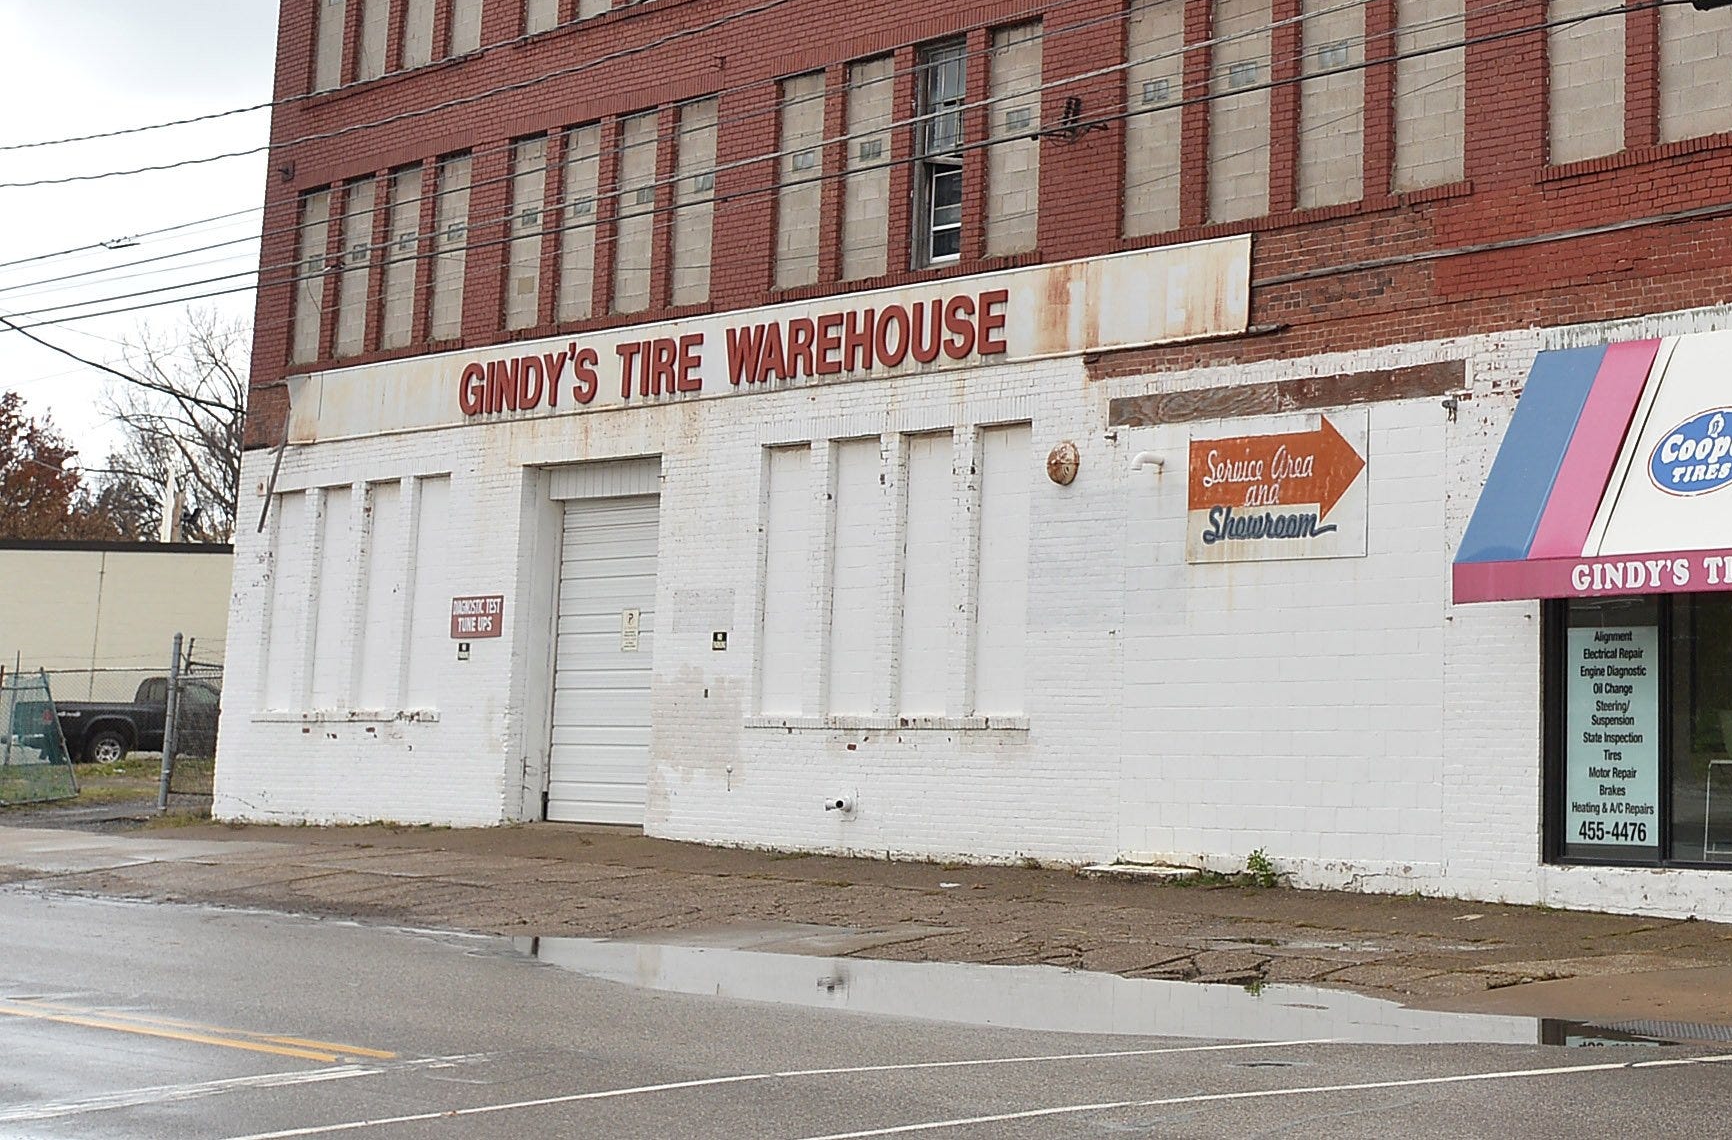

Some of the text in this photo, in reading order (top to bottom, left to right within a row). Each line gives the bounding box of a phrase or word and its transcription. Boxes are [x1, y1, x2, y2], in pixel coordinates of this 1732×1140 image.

[459, 290, 1008, 416] GINDY'S TIRE WAREHOUSE
[1203, 444, 1314, 487] Service Area
[1671, 462, 1731, 484] TIRES
[1245, 480, 1280, 507] and
[1203, 506, 1337, 544] Showroom
[1572, 559, 1690, 591] GINDY'S
[486, 598, 501, 613] TEST
[458, 616, 492, 632] TUNE UPS
[1594, 631, 1632, 643] Alignment
[1584, 649, 1643, 660] Electrical Repair
[1581, 665, 1646, 678] Engine Diagnostic
[1593, 684, 1632, 695] Oil Change
[1596, 701, 1629, 713] Steering/
[1591, 715, 1634, 727] Suspension
[1583, 732, 1643, 745] State Inspection
[1604, 750, 1622, 760] Tires
[1589, 767, 1636, 779] Motor Repair
[1600, 785, 1625, 796] Brakes
[1572, 802, 1654, 815] Heating & A/C Repairs
[1579, 821, 1646, 842] 455-4476
